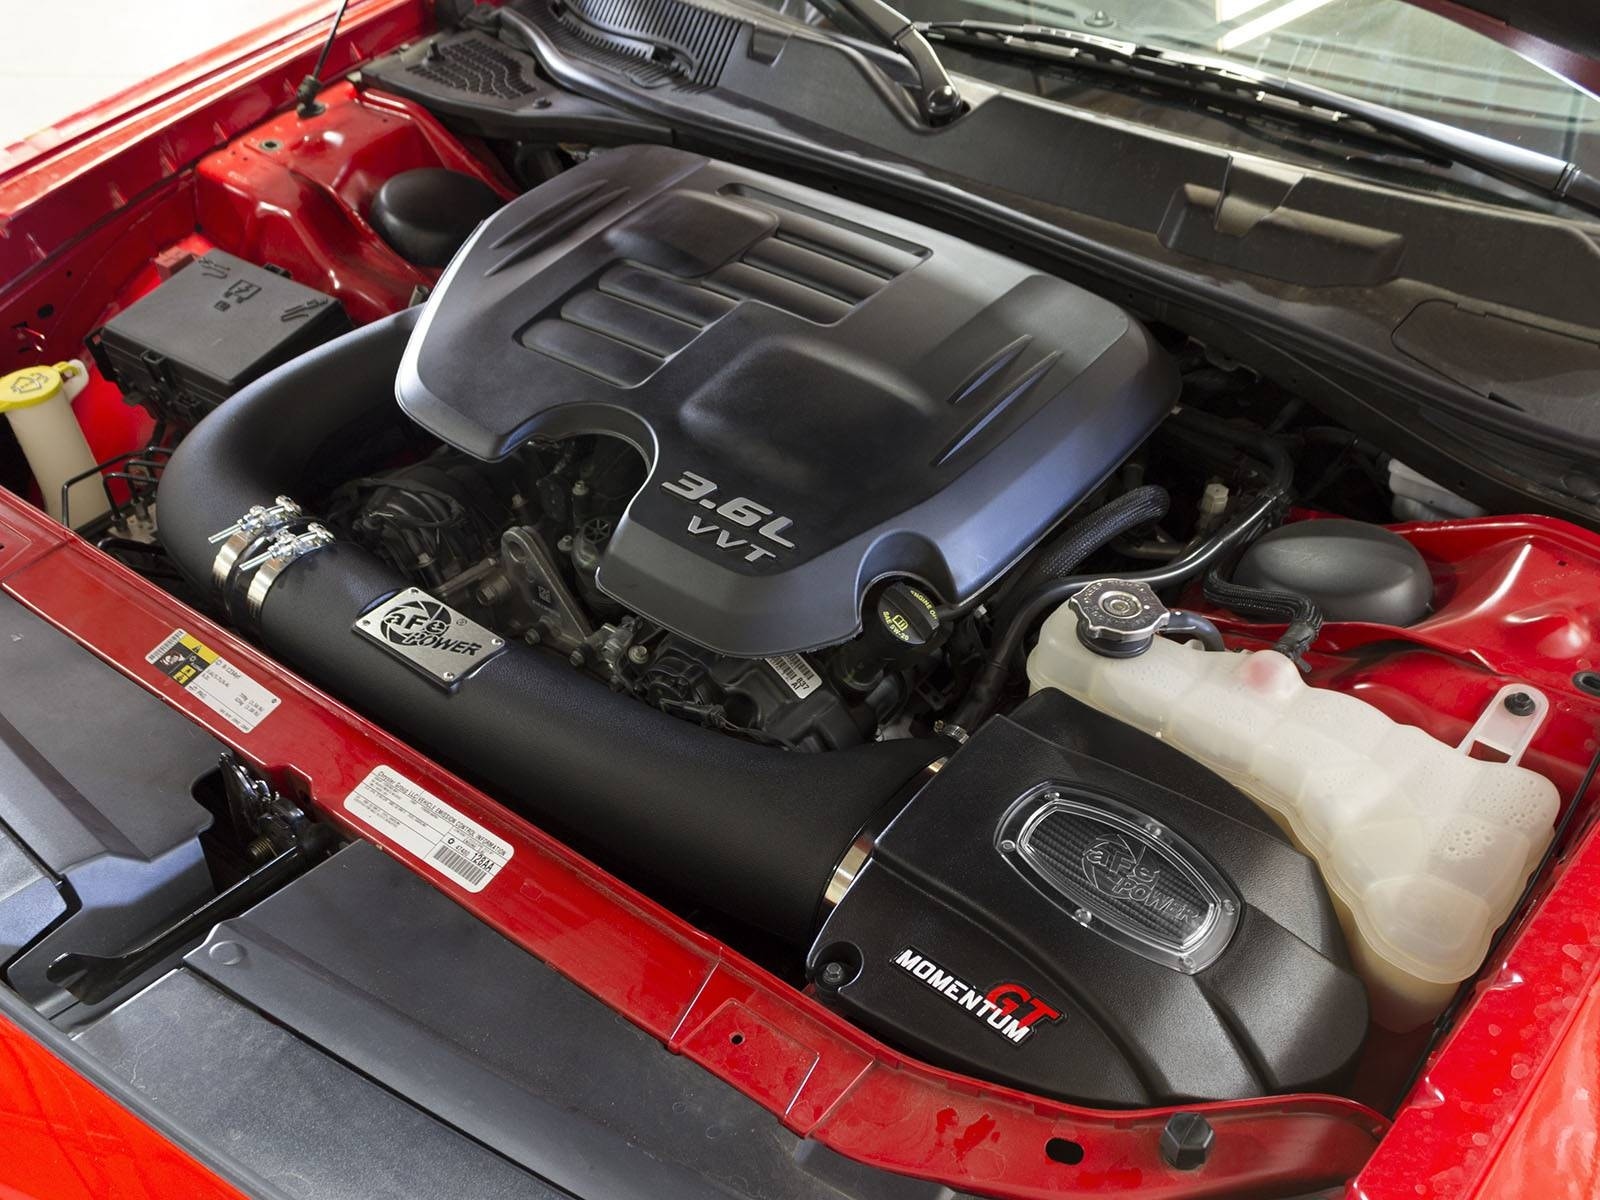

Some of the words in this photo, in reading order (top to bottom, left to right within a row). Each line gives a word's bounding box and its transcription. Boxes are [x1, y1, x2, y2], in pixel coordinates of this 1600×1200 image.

[661, 471, 796, 549] 3.6L
[687, 515, 777, 562] VVT
[384, 612, 448, 636] aFe
[402, 632, 482, 656] POWER
[455, 821, 476, 836] CONTROL
[475, 834, 507, 856] INFORMATION
[471, 852, 495, 872] 128AA
[895, 949, 1030, 1043] MOMENTUM
[986, 983, 1061, 1029] GT
